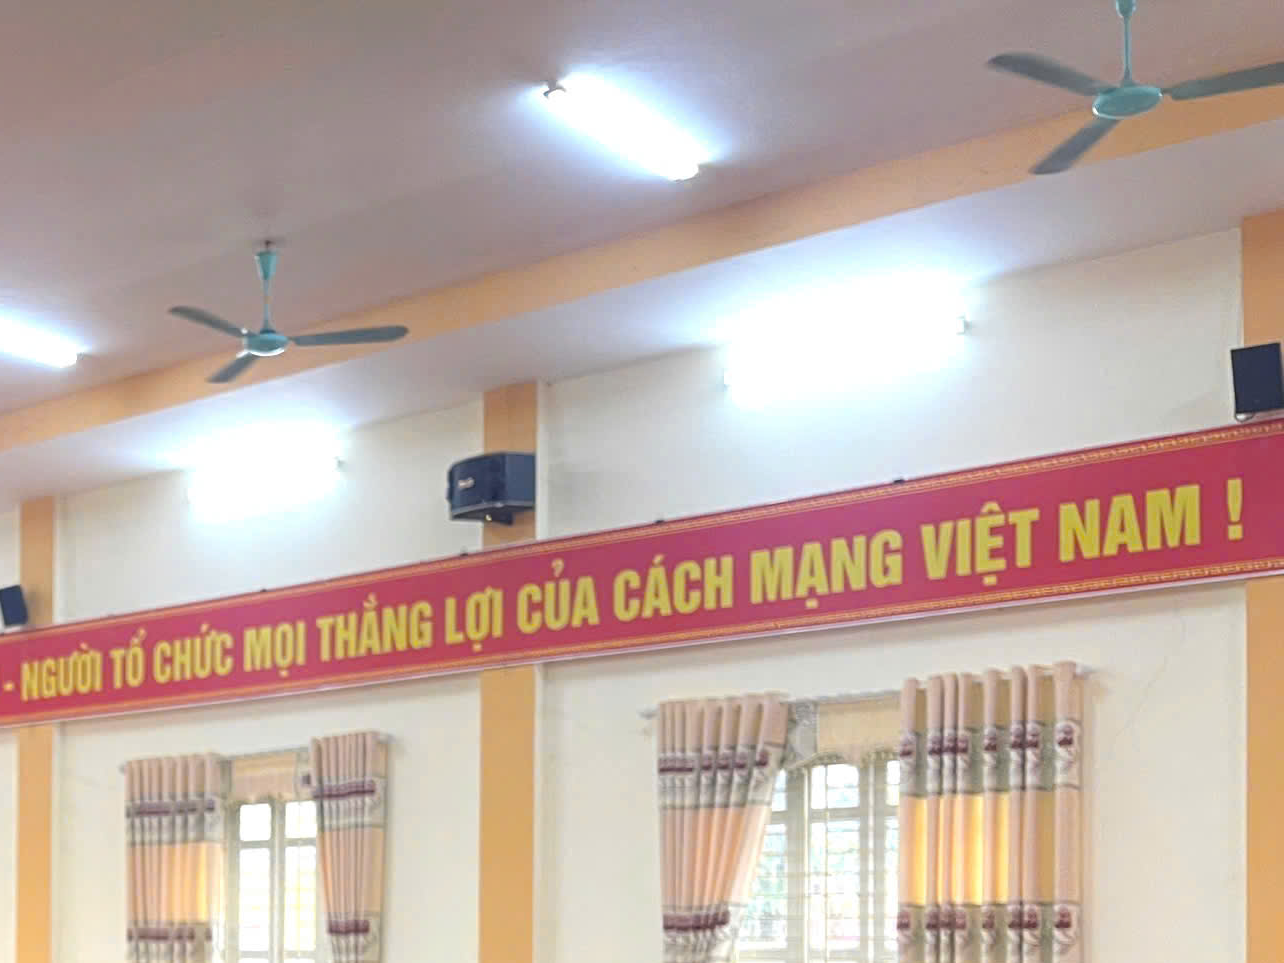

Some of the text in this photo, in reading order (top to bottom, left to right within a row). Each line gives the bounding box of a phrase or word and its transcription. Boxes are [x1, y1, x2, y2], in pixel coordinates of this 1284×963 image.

[3, 682, 14, 692] -
[20, 642, 103, 701] NGƯỜI
[110, 627, 147, 690] TỔ
[153, 622, 233, 684] CHỨC
[243, 619, 307, 678] MỌI
[316, 593, 433, 662] THẮNG
[445, 586, 504, 652] LỢI
[517, 558, 600, 634] CỦA
[613, 554, 734, 622] CÁCH
[750, 529, 904, 609] MẠNG
[920, 501, 1040, 586] VIỆT
[1059, 484, 1202, 563] NAM
[1227, 478, 1244, 541] !
